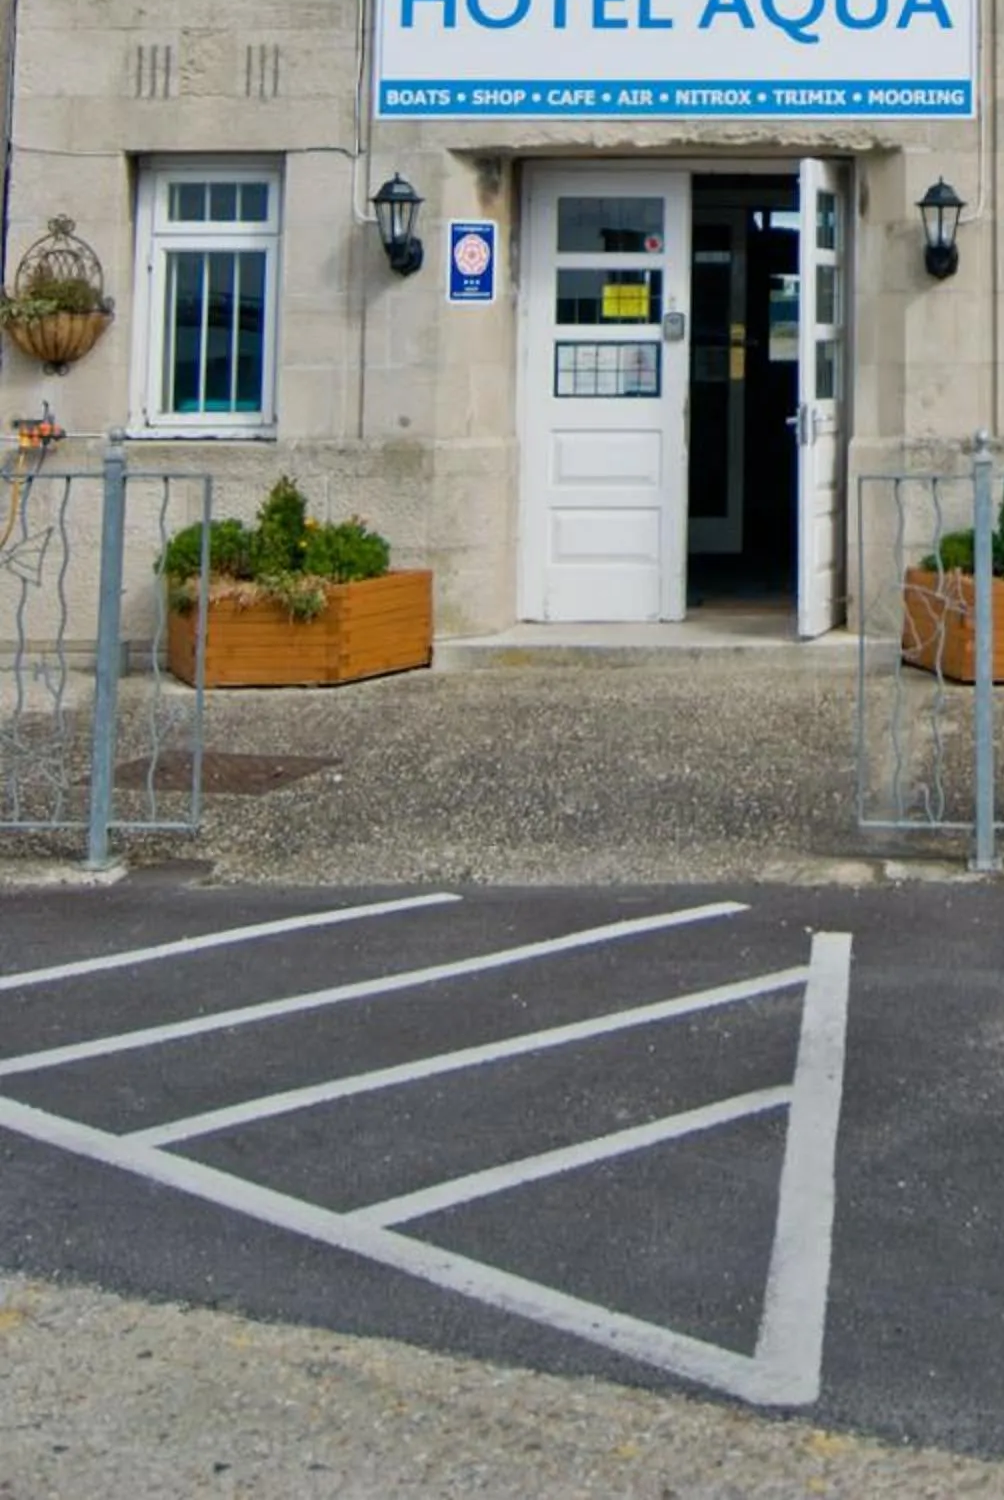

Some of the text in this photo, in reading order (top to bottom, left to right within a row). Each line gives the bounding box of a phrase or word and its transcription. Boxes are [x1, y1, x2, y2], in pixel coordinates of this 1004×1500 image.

[386, 89, 965, 106] BOATS SHOP CAFE AIR NITROX TRIMIX MOORING
